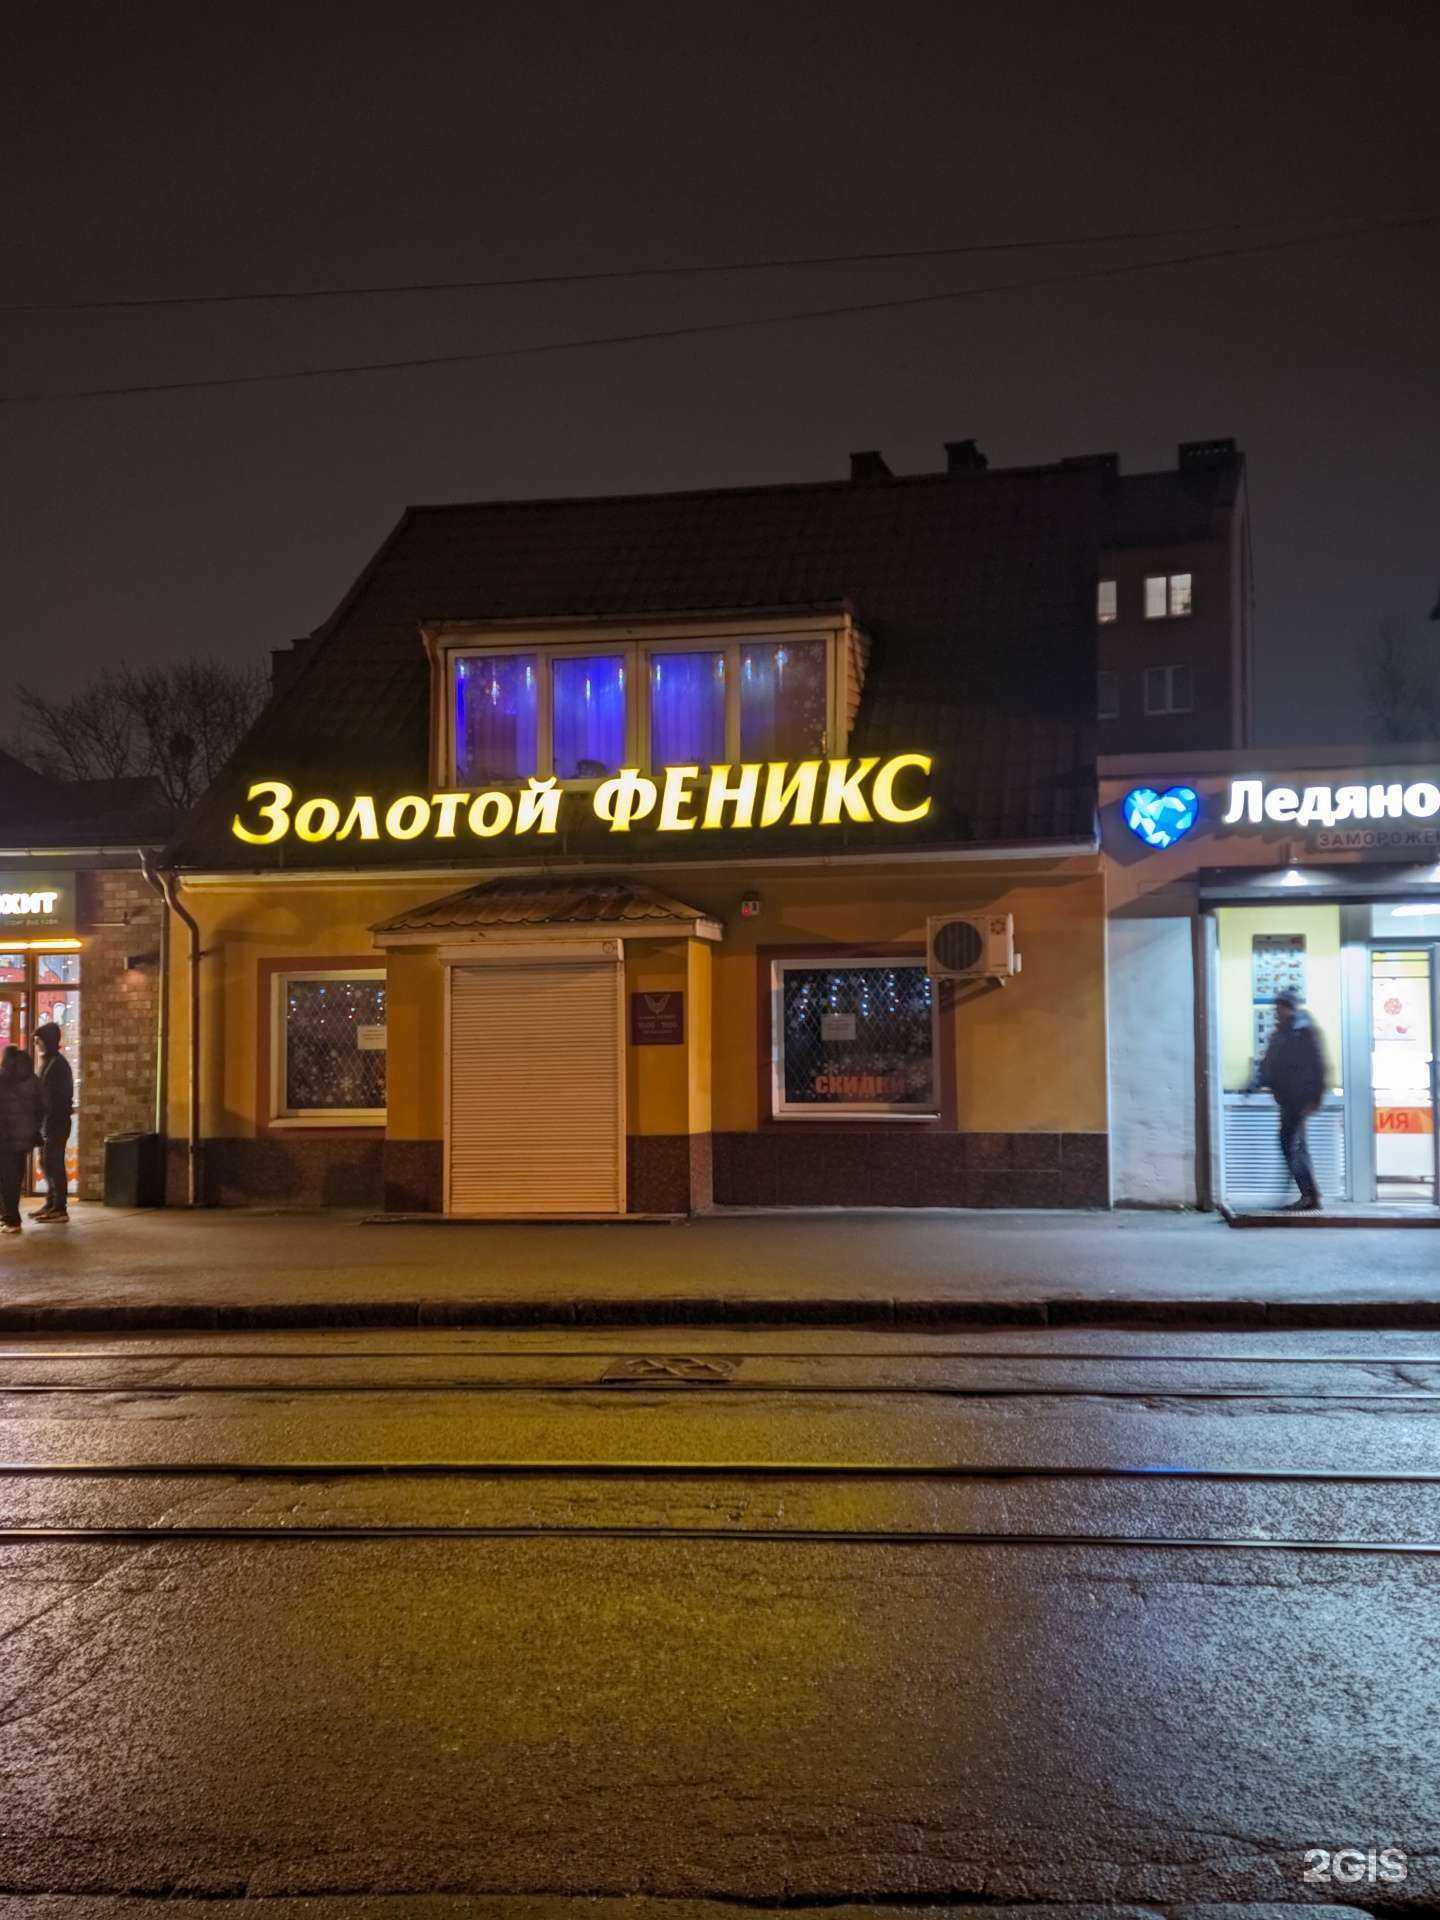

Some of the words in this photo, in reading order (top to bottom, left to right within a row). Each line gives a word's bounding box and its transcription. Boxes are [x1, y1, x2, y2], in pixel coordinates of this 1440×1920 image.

[593, 753, 932, 832] ФЕНИКС
[1224, 780, 1440, 827] Ледяно
[1319, 831, 1440, 847] ЗАМОРОЖЕ
